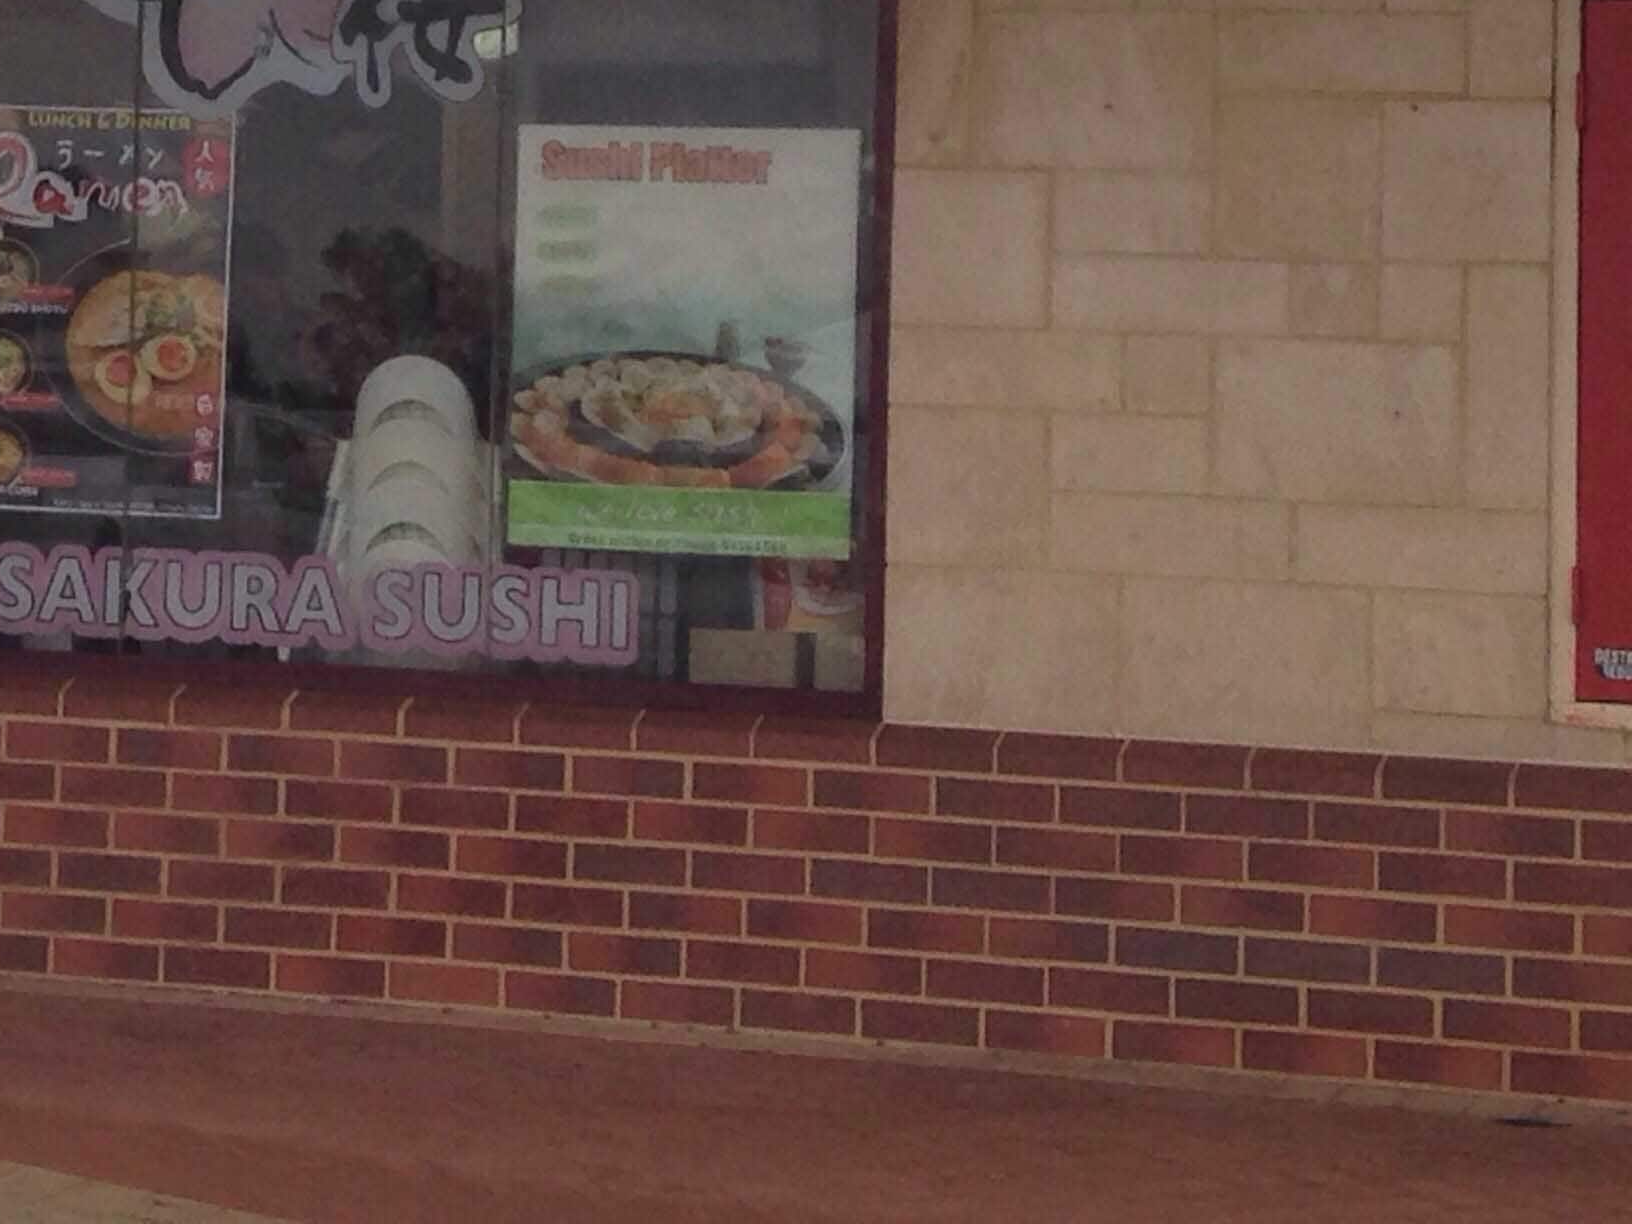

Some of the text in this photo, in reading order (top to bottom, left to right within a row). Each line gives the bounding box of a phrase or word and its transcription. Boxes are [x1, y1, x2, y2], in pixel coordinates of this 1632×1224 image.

[28, 111, 91, 129] LUNCH
[541, 139, 771, 185] Sushi Platter
[370, 566, 630, 652] SUSHI
